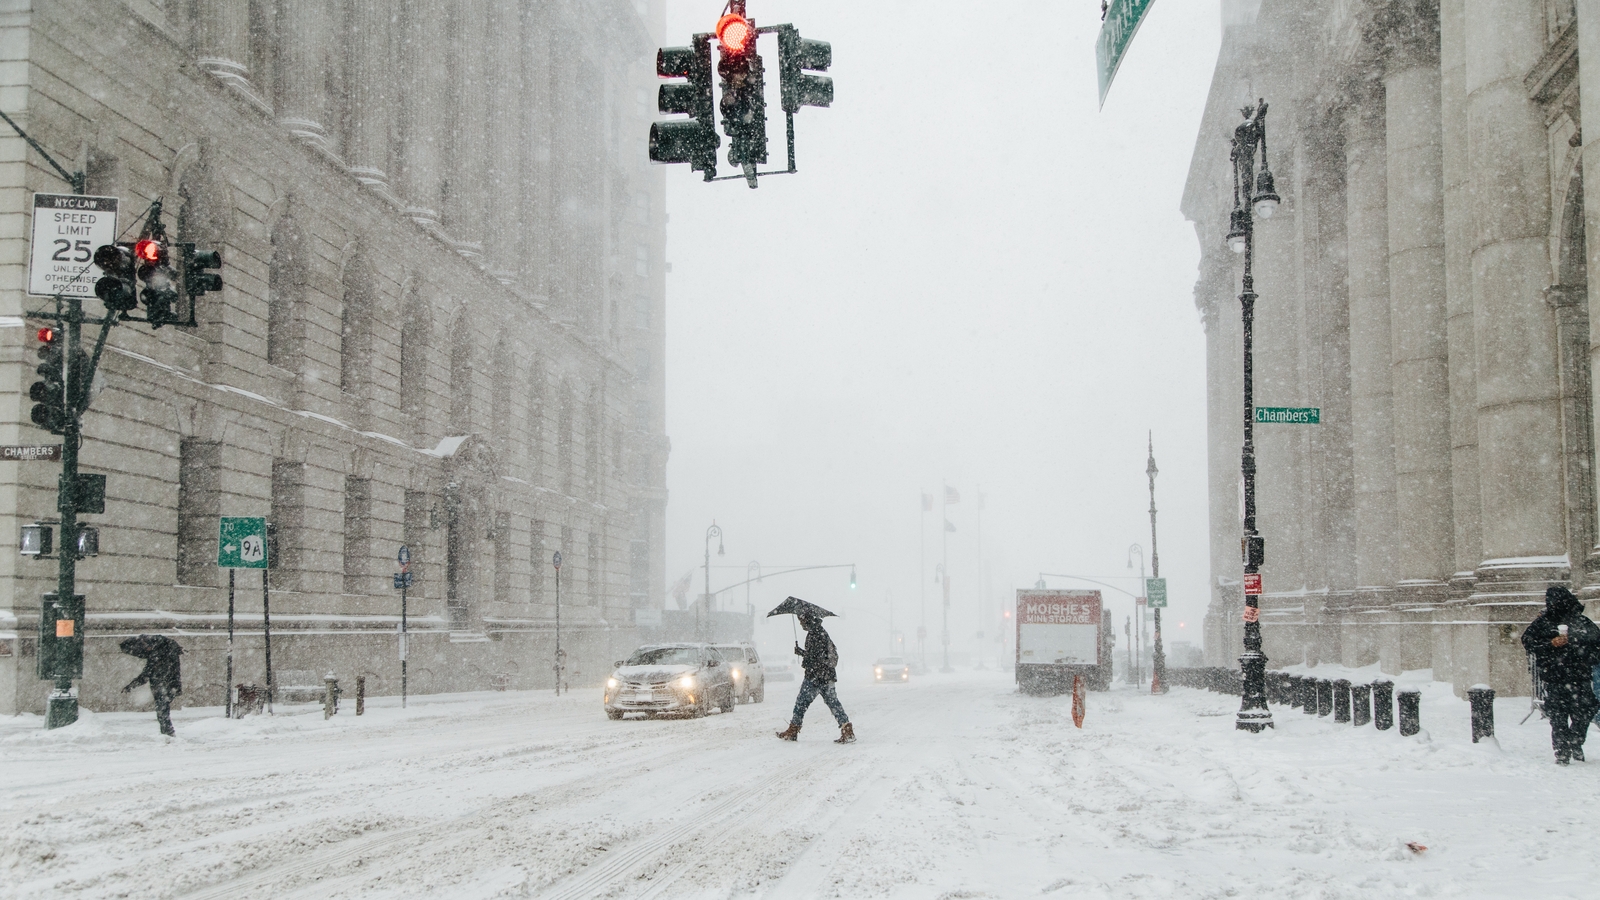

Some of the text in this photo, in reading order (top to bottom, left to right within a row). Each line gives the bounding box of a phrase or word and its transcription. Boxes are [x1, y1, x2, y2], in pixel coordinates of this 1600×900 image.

[54, 198, 97, 209] NYC LAW
[54, 212, 97, 224] SPEED
[58, 225, 92, 236] LIMIT
[52, 238, 92, 262] 25
[53, 265, 91, 274] UNLESS
[45, 274, 98, 284] OTHERWISE
[52, 284, 89, 293] POSTED
[1256, 409, 1309, 422] Chambers
[4, 446, 54, 456] CHAMBERS
[243, 540, 262, 557] 9A
[1048, 614, 1091, 623] STORAGE
